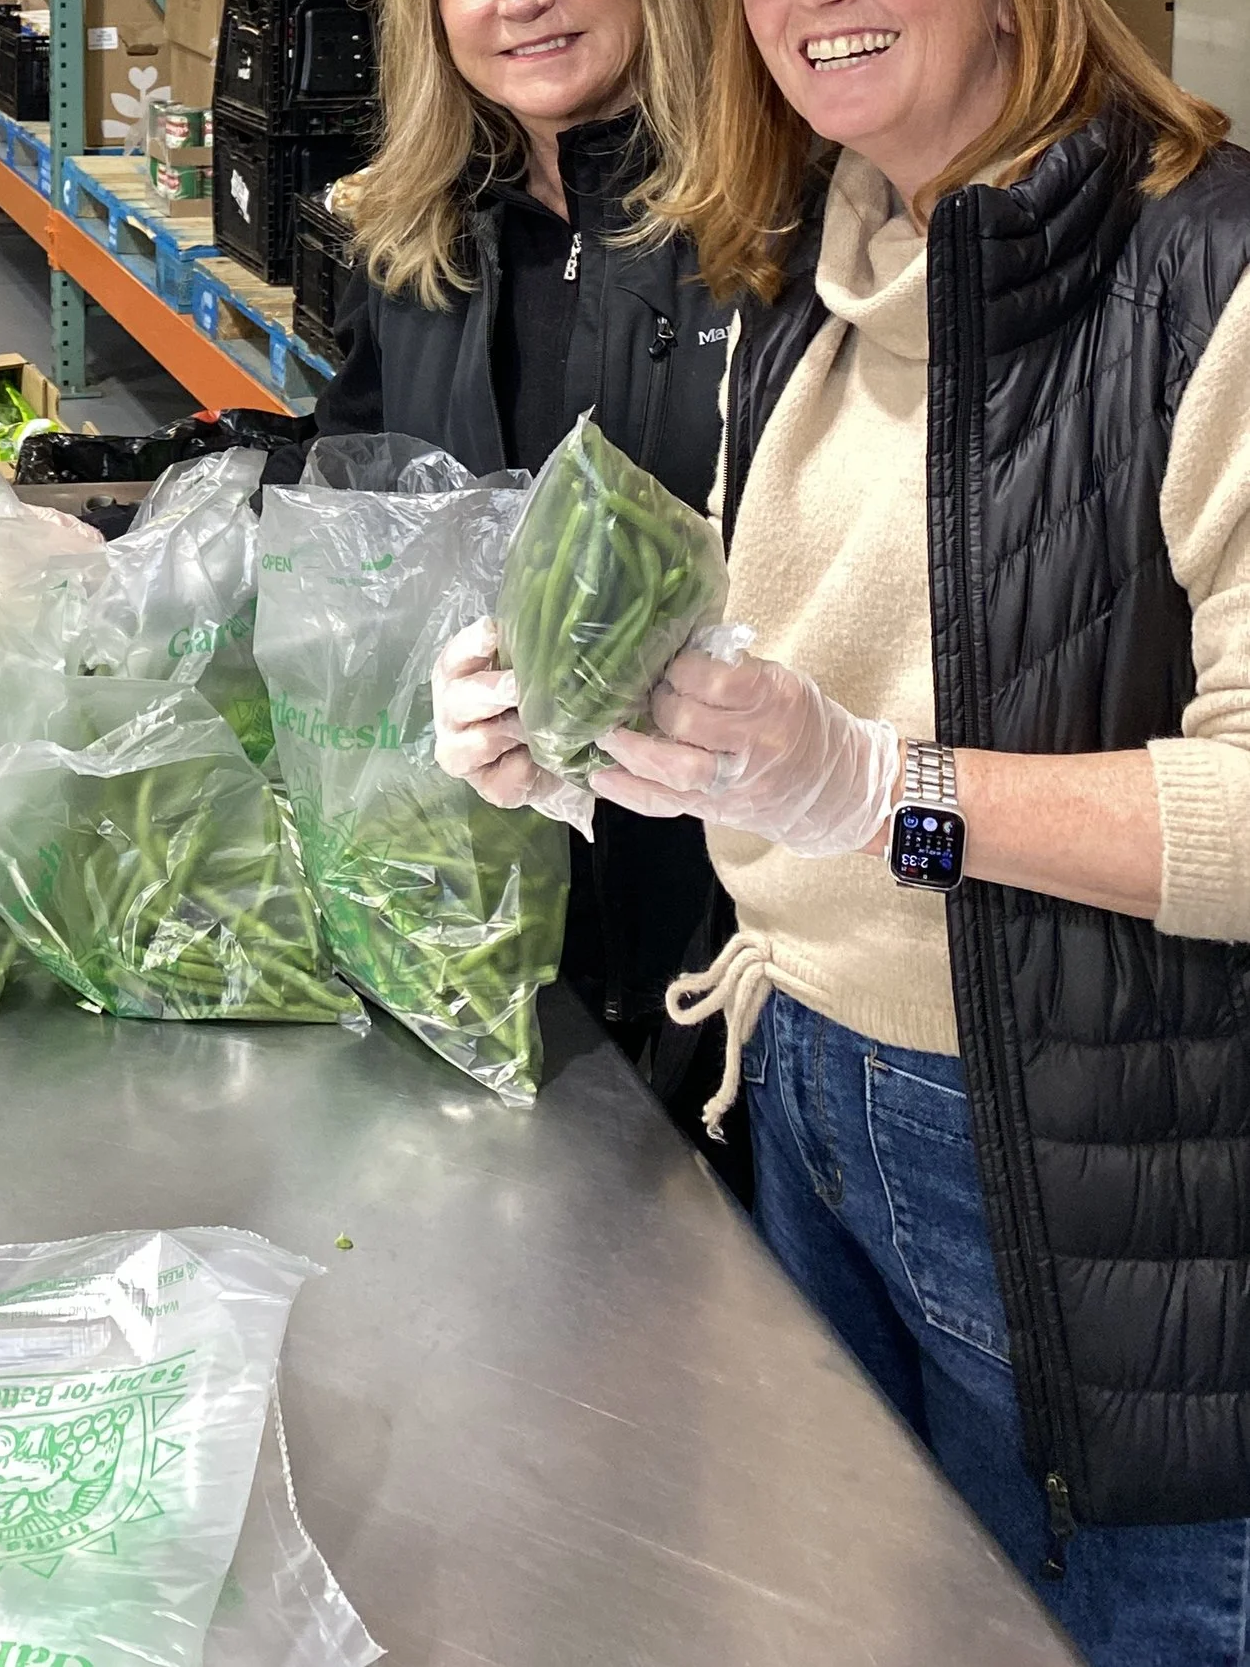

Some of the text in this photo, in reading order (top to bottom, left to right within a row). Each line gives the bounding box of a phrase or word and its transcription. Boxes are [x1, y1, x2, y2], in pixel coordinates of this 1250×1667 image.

[261, 552, 293, 573] OPEN
[901, 853, 930, 869] 2:33
[150, 1369, 165, 1383] a
[170, 1363, 187, 1380] 5
